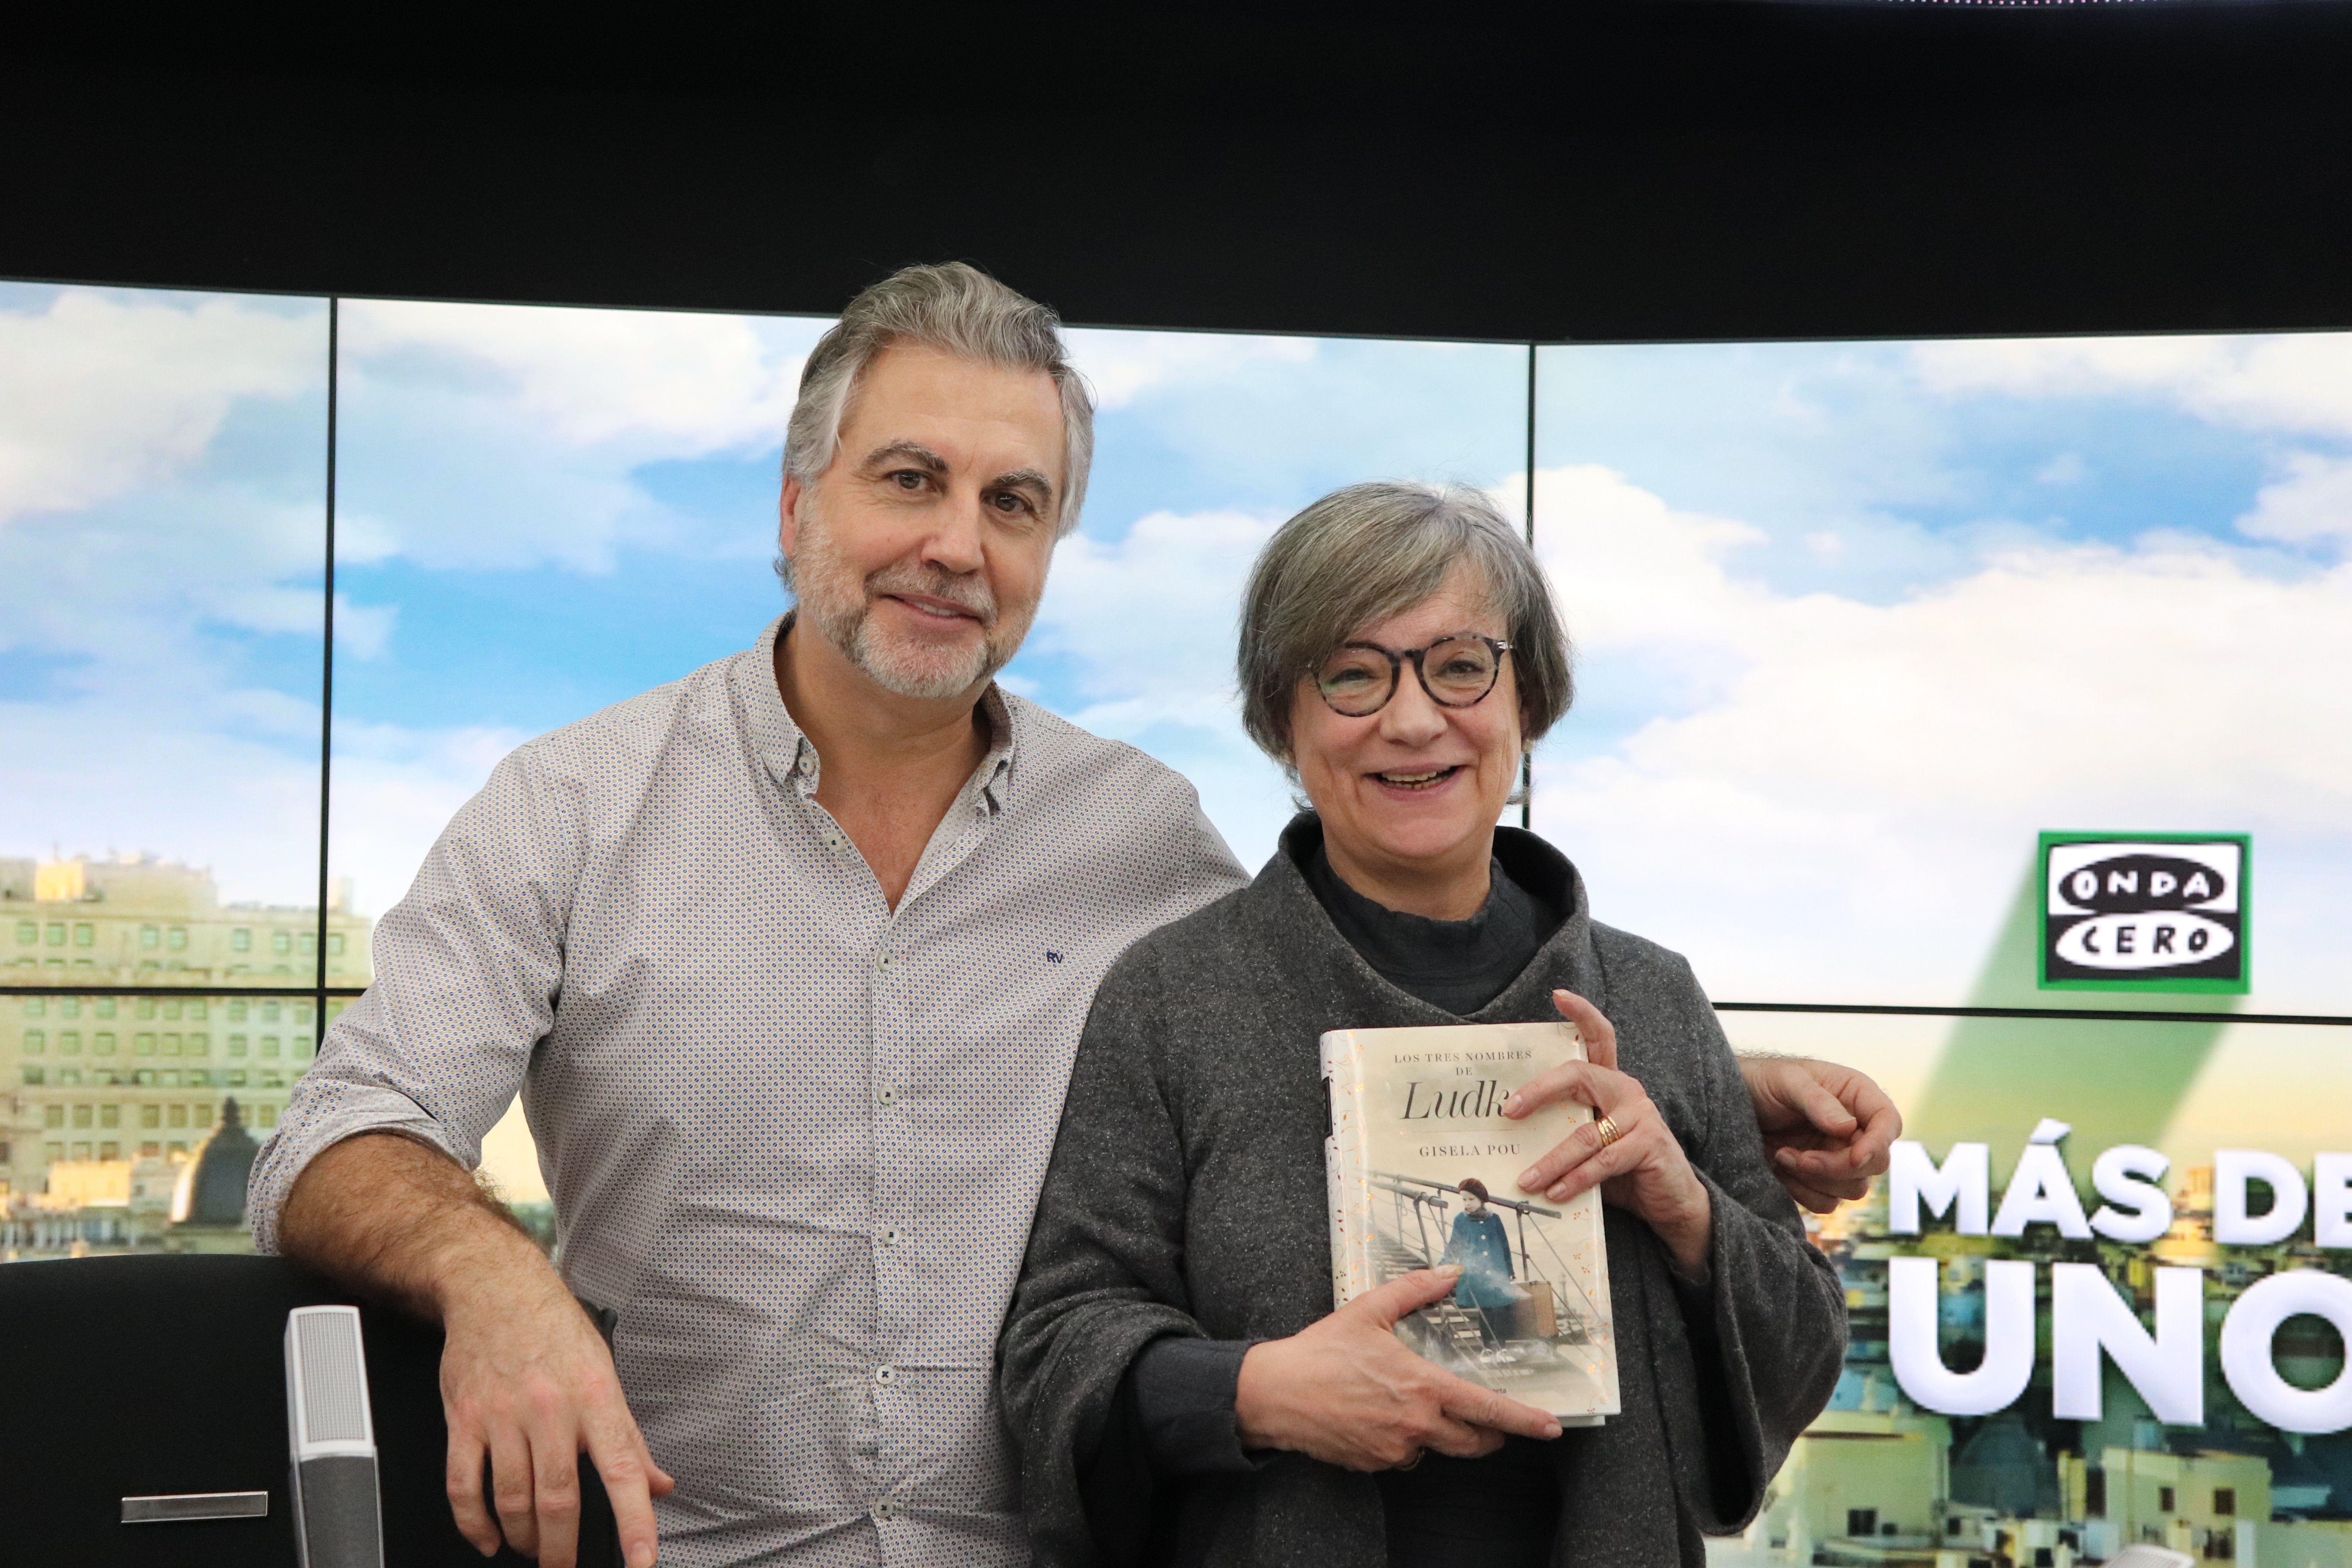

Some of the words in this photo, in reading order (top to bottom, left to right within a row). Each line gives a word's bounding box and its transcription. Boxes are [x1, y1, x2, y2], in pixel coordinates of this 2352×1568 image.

[2072, 870, 2210, 900] ONDA
[2082, 924, 2209, 955] CERO
[1395, 1054, 1420, 1063] LOS
[1425, 1053, 1459, 1062] TRES
[1466, 1051, 1532, 1061] NOMBRES
[1455, 1067, 1472, 1076] DE
[1399, 1080, 1509, 1120] Ludk
[1419, 1145, 1480, 1156] GISELA
[1487, 1144, 1520, 1155] POU
[1889, 1118, 2172, 1243] MÁS
[1889, 1256, 2352, 1434] UNO
